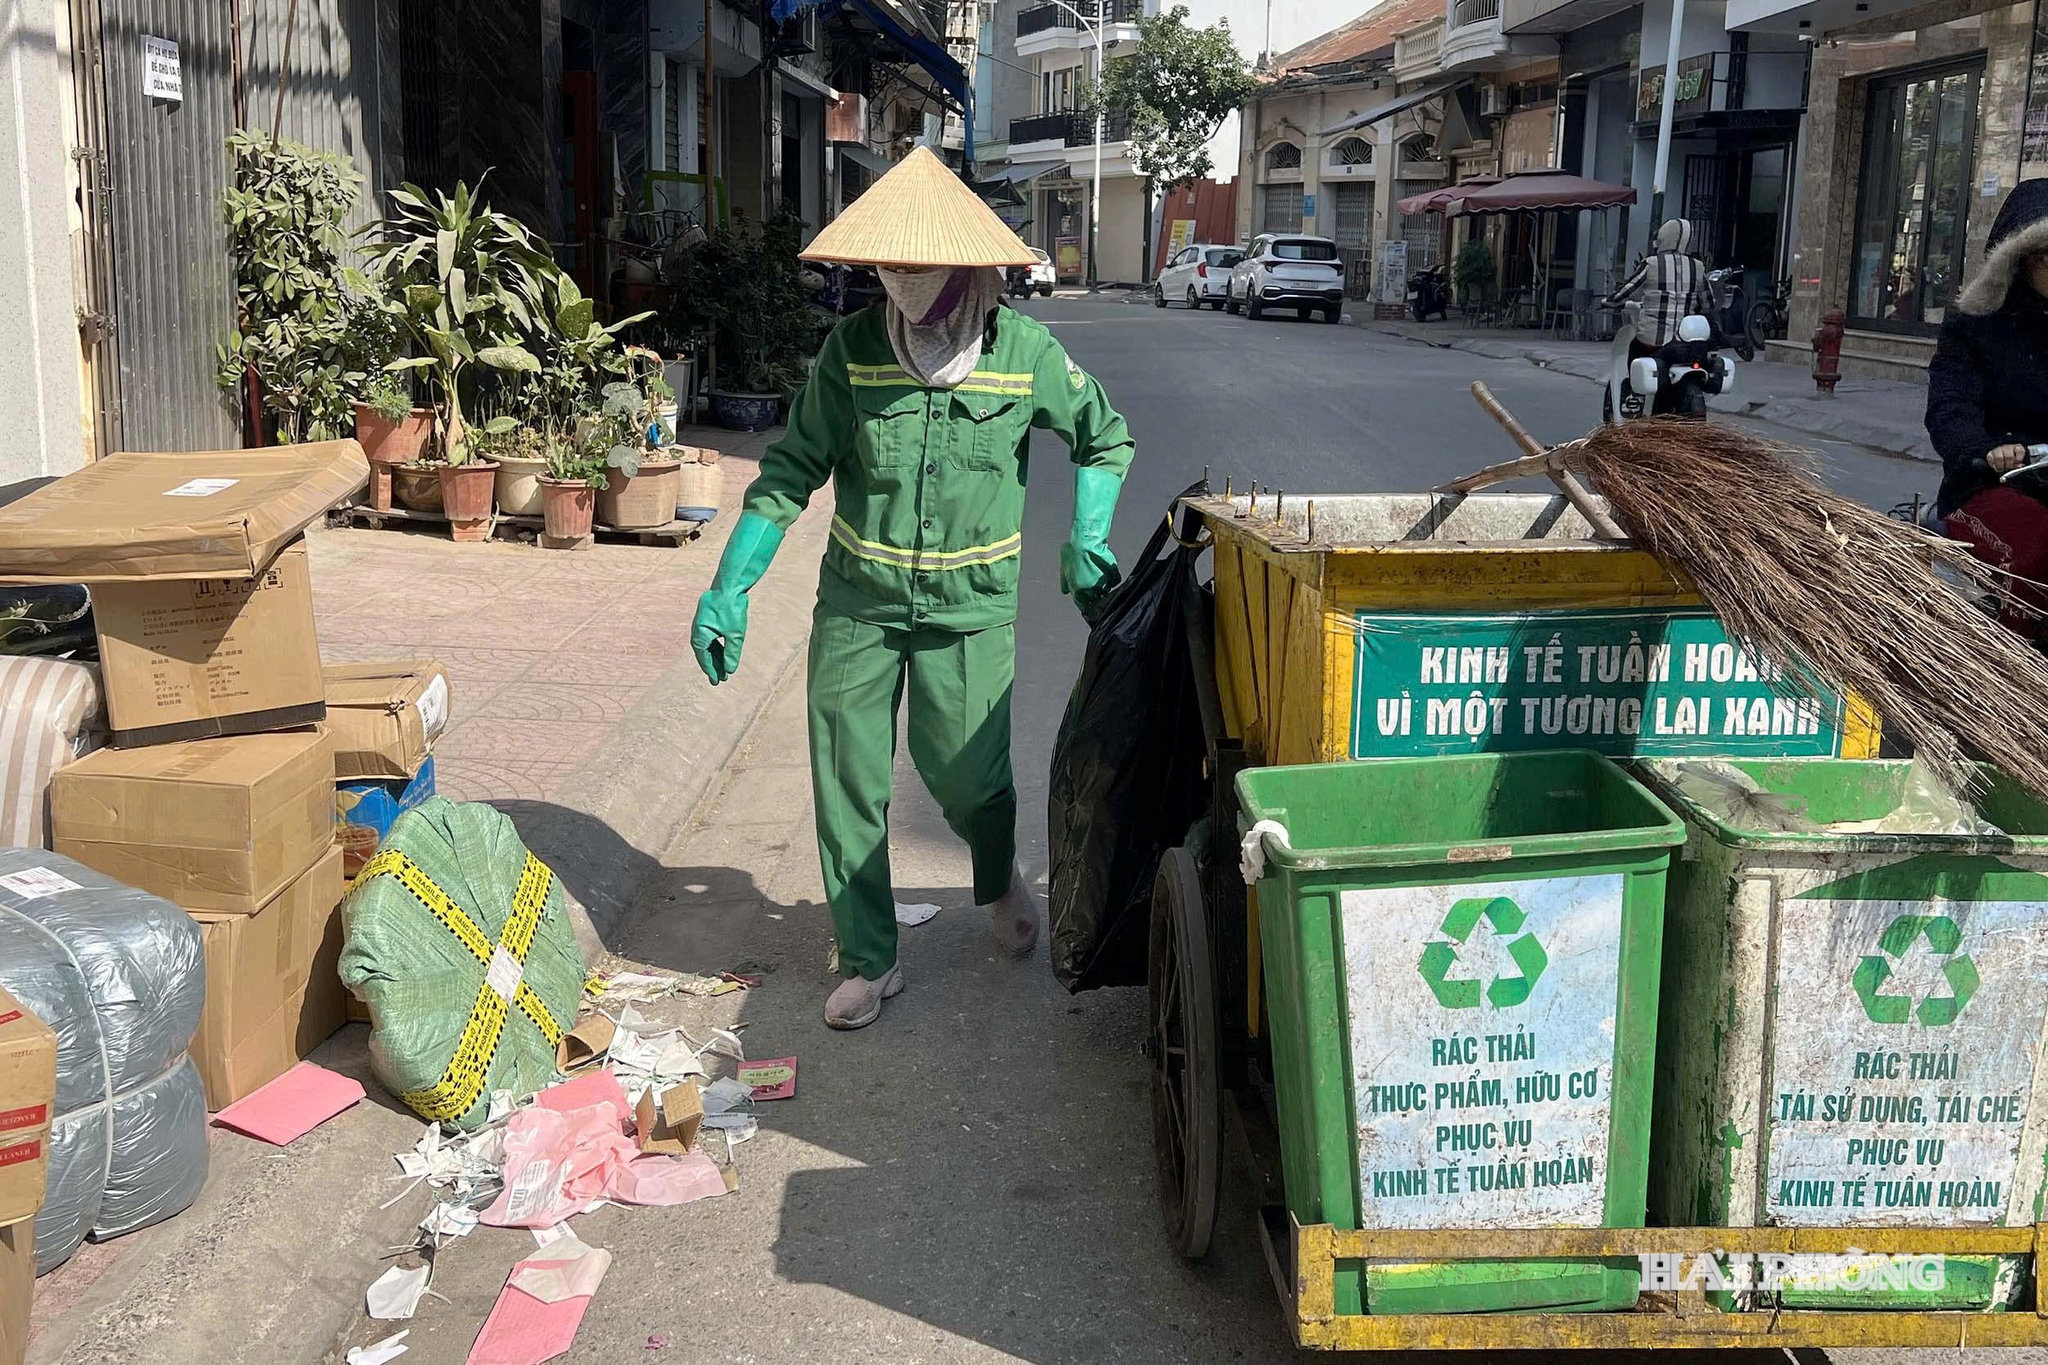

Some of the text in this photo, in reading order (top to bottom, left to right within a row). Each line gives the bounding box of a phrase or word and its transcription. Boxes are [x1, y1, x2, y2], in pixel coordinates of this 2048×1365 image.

[1420, 646, 1509, 684] KINH
[1524, 632, 1564, 683] TẾ
[1577, 631, 1671, 683] TUẦN
[1377, 690, 1821, 743] VÌ MỘT TƯƠNG LAI XANH
[412, 872, 441, 902] FRAGILE
[479, 1016, 495, 1051] FRAGILE
[1432, 1023, 1536, 1066] RÁC THẢI
[1853, 1043, 1959, 1080] RÁC THẢI
[443, 1081, 474, 1111] FRAGILE
[1369, 1067, 1598, 1118] THỰC PHẨM, HỮU CƠ
[1780, 1086, 2024, 1129] TÁI SỬ DỤNG, TÁI CHẾ
[1436, 1120, 1532, 1156] PHỤC VỤ
[1847, 1139, 1944, 1171] PHỤC VỤ
[1373, 1152, 1593, 1197] KINH TẾ TUẦN HOÀN
[1779, 1172, 2000, 1207] KINH TẾ TUẦN HOÀN
